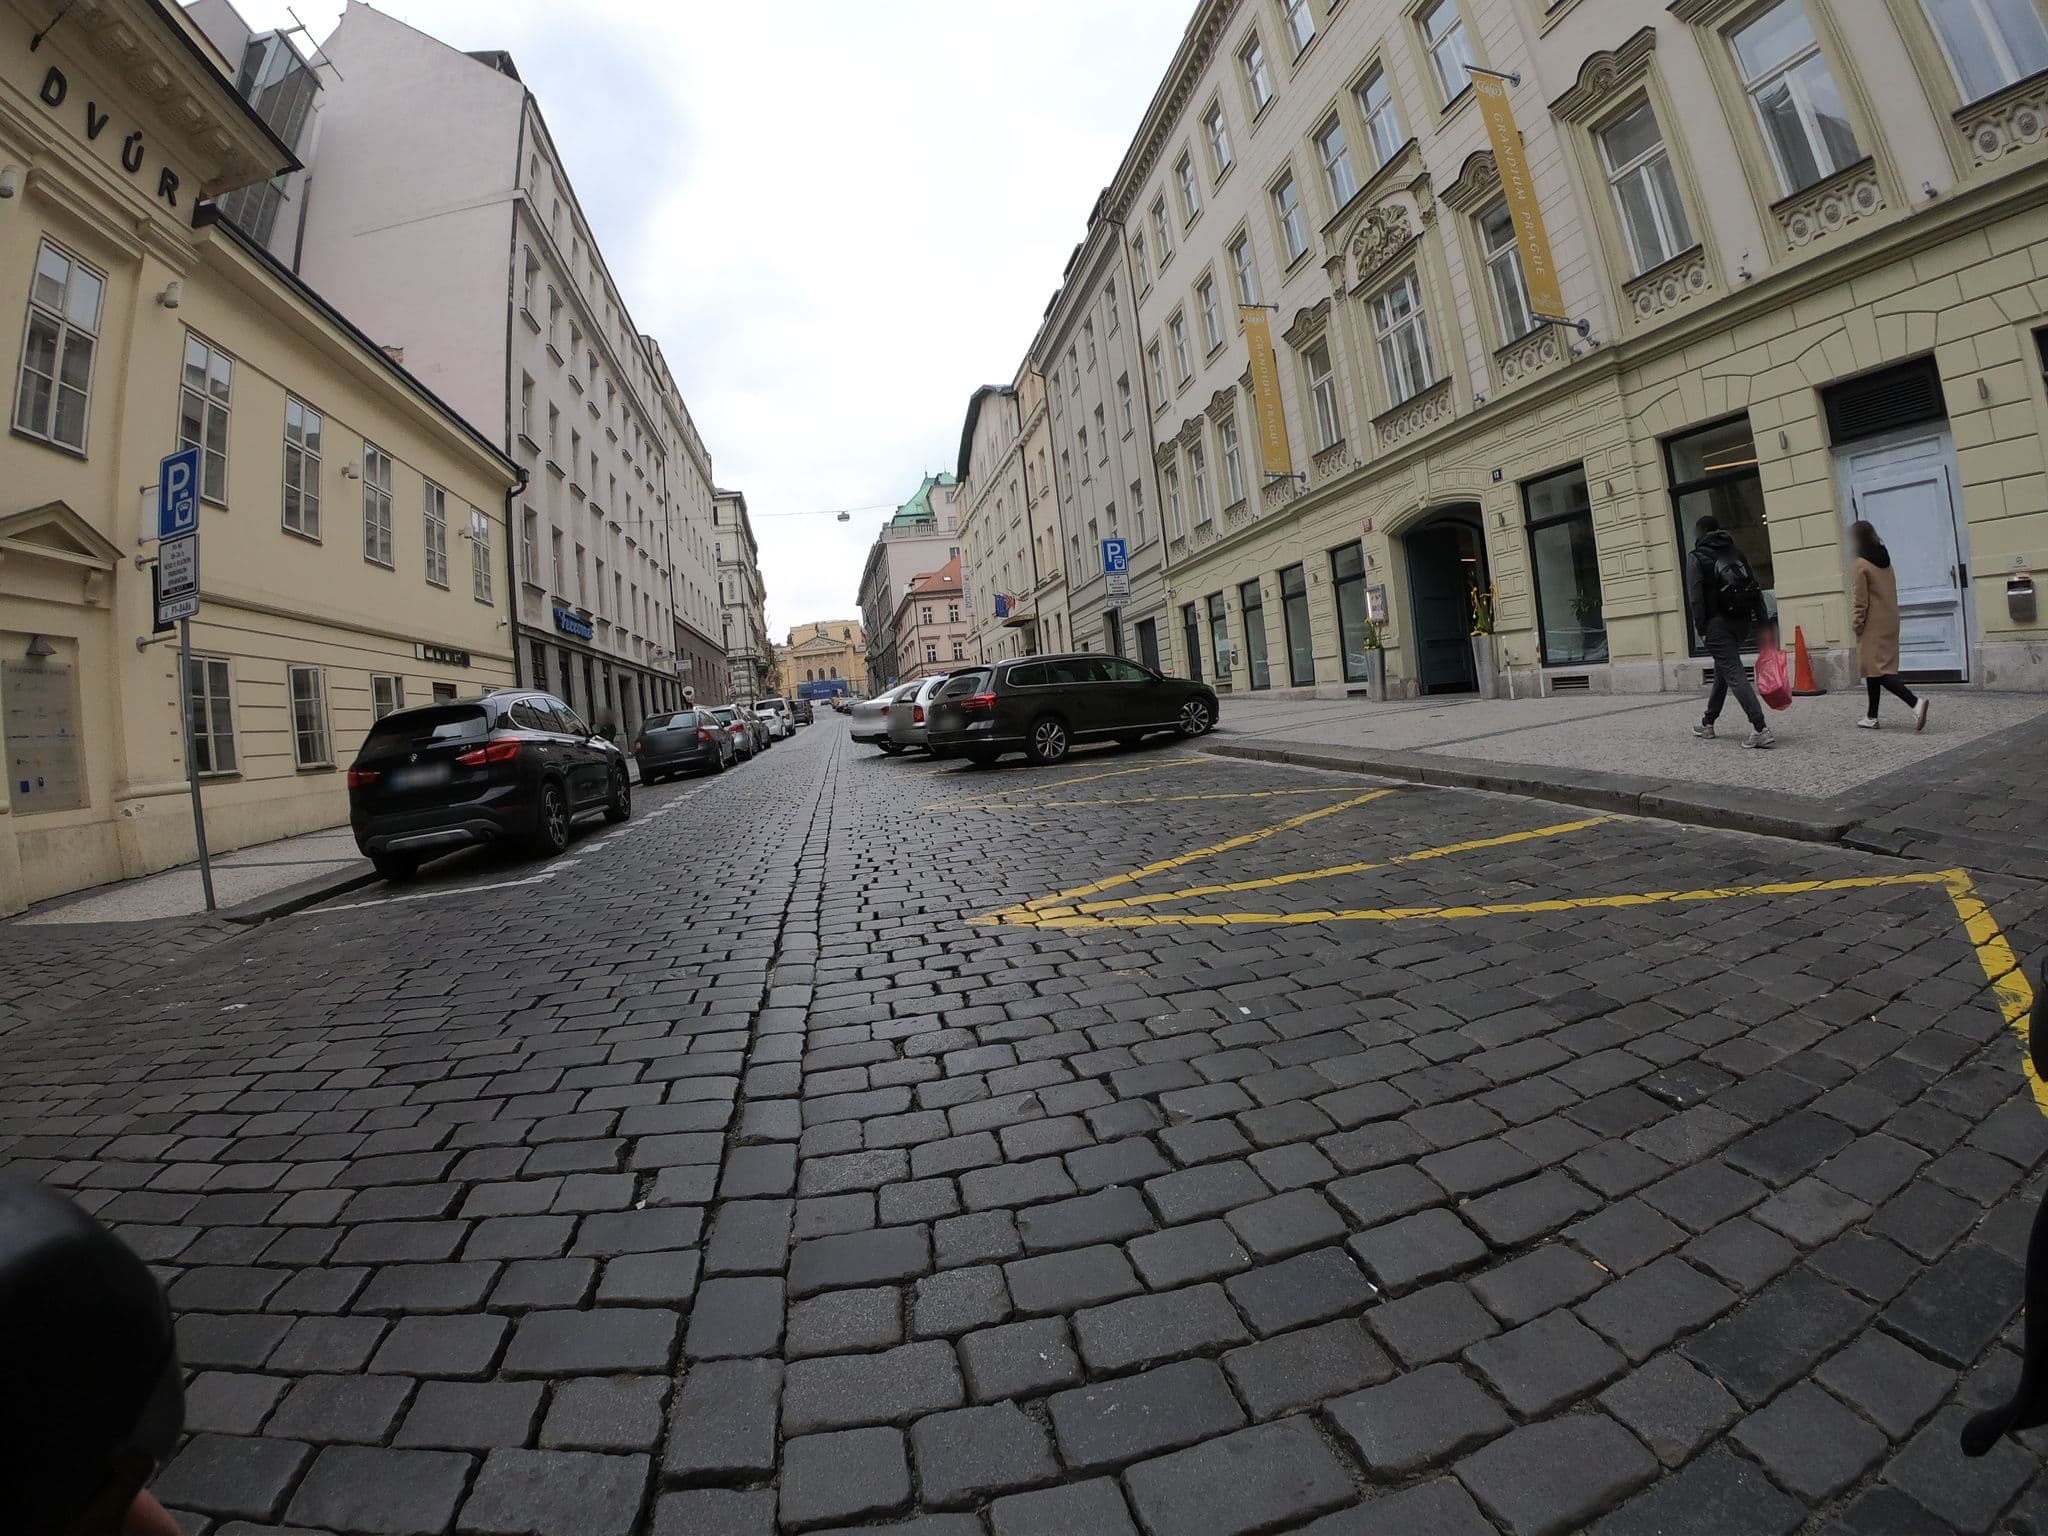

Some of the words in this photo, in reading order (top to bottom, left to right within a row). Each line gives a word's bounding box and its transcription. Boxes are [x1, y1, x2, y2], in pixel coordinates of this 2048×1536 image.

[1493, 111, 1526, 200] GRANDIUM
[1521, 210, 1545, 275] PRAGUE
[167, 461, 190, 512] P
[1108, 543, 1121, 563] P
